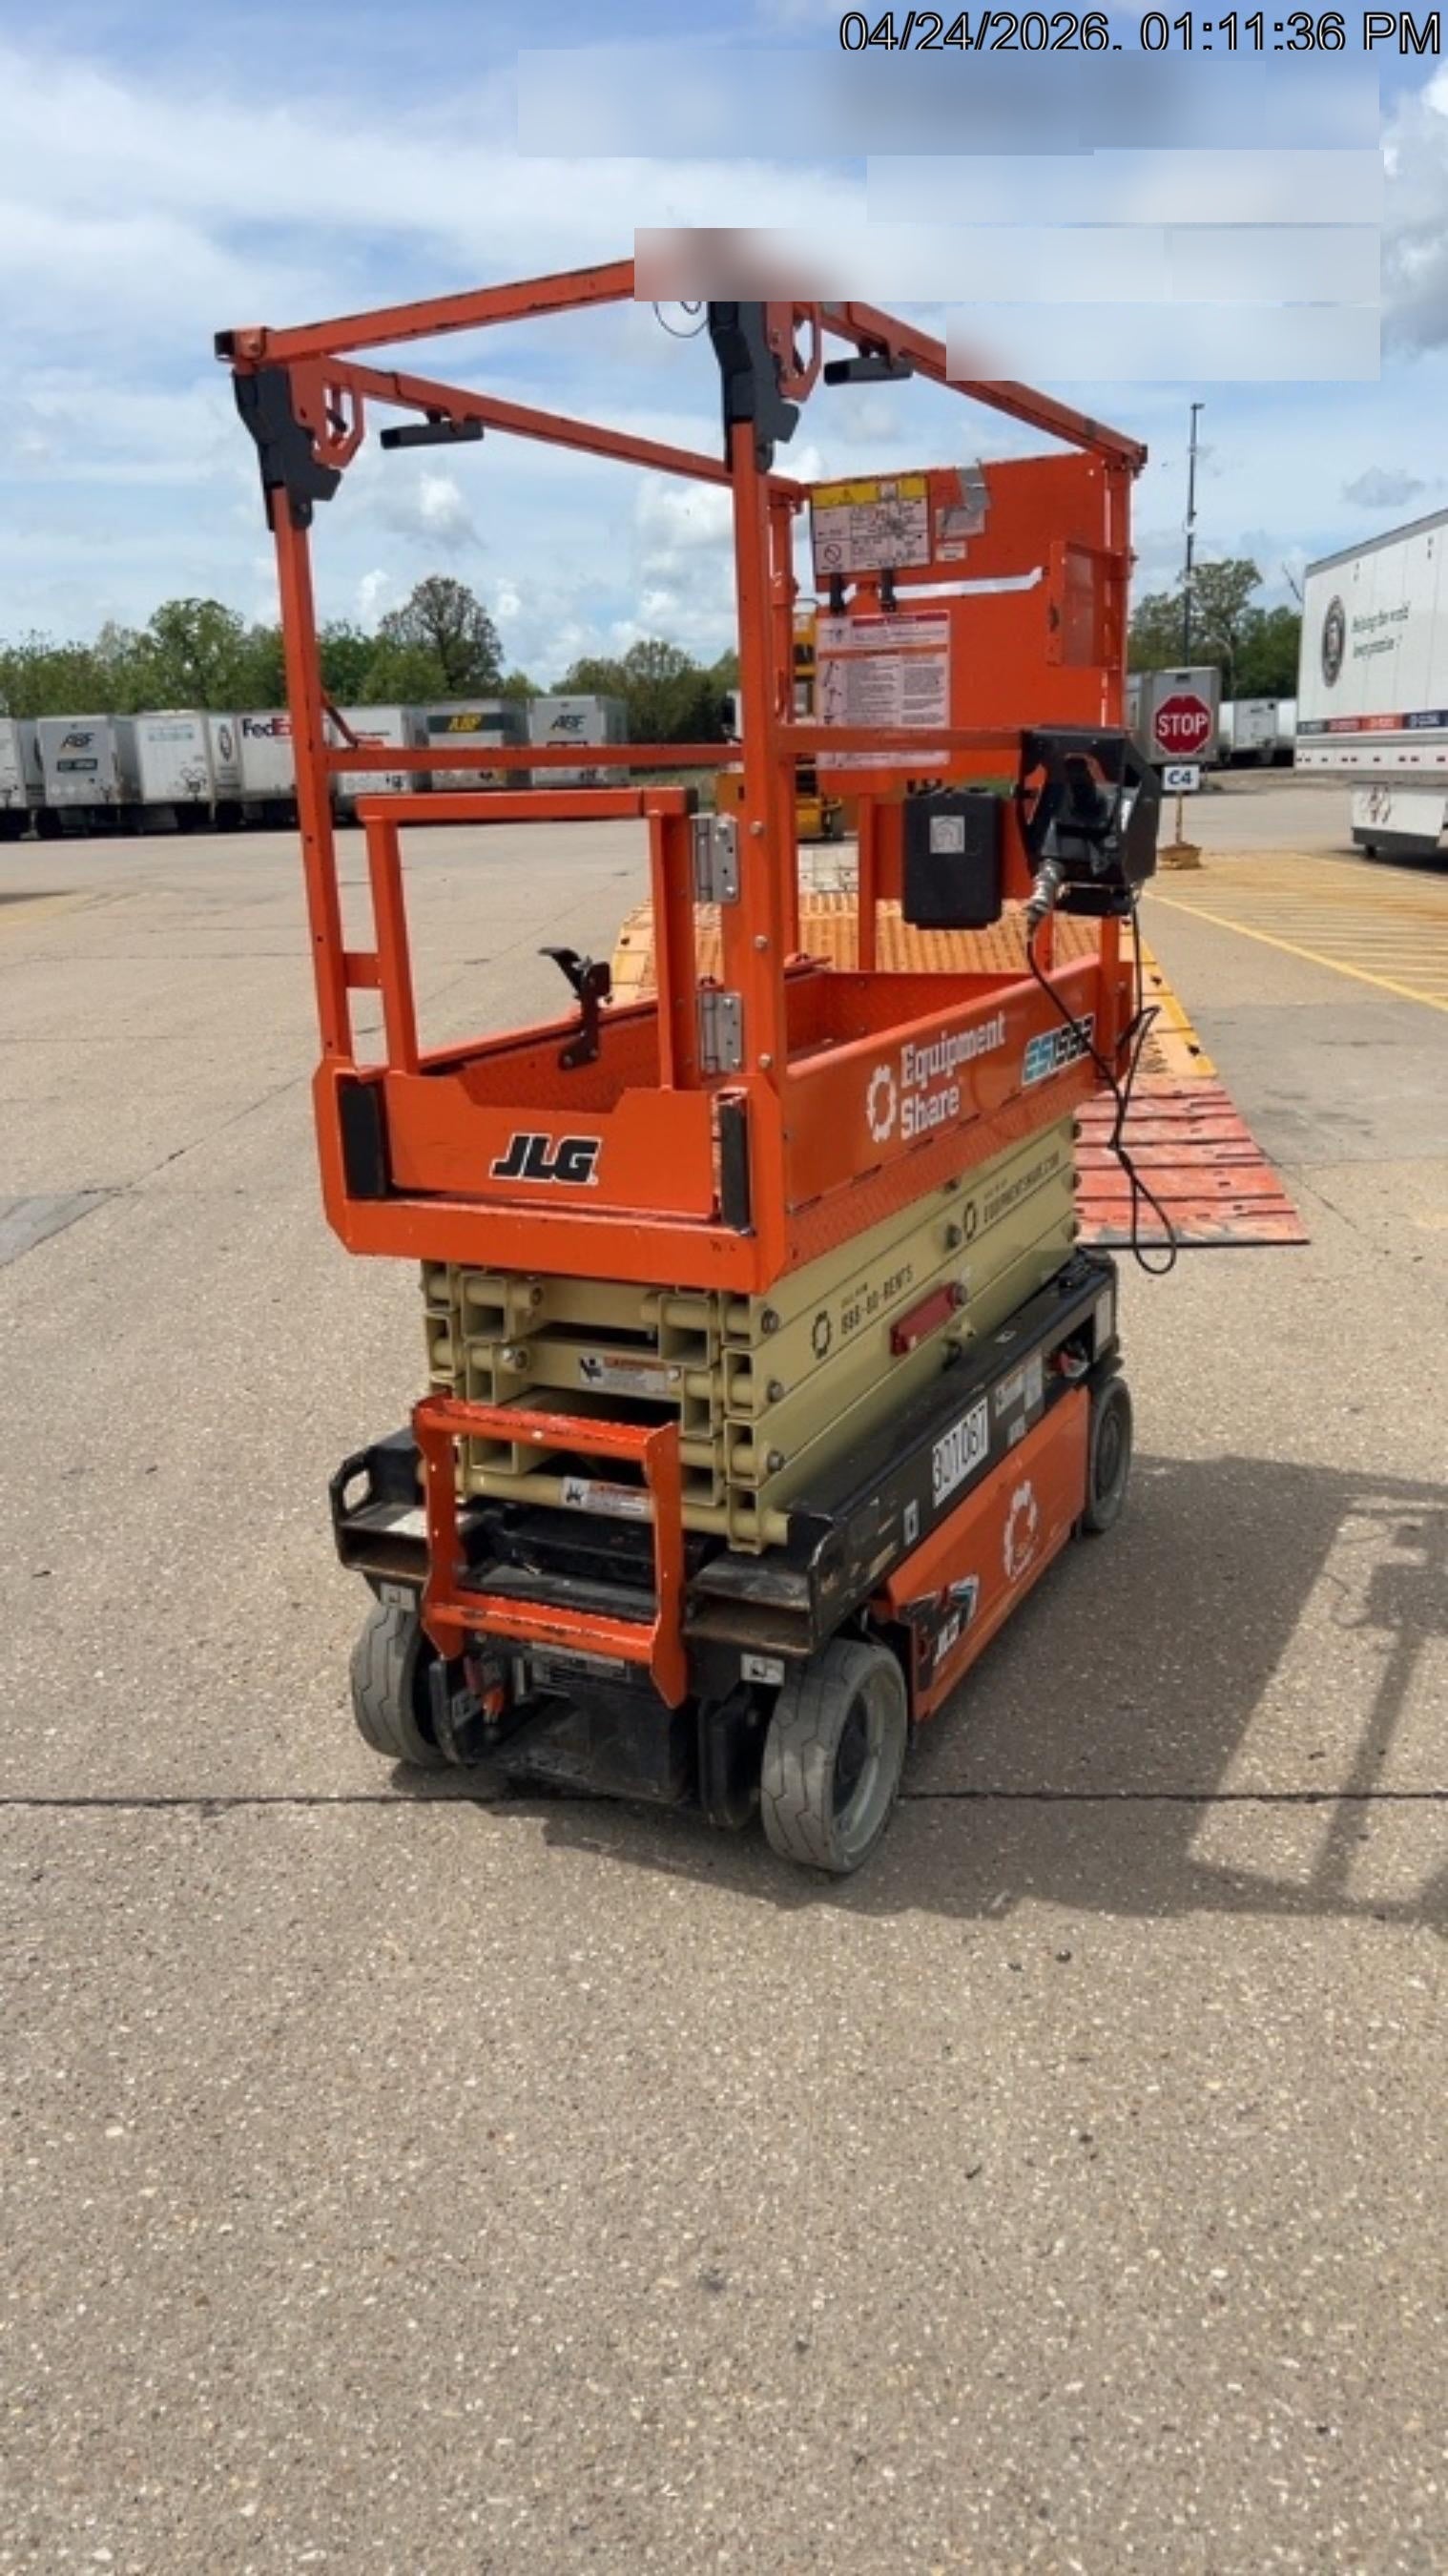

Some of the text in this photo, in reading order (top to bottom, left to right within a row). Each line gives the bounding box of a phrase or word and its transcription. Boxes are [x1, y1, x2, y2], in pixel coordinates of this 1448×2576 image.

[1157, 714, 1209, 737] STOP
[1167, 770, 1192, 785] C4
[900, 1010, 1006, 1089] Equipment
[900, 1083, 961, 1140] Share
[490, 1132, 601, 1184] JLG
